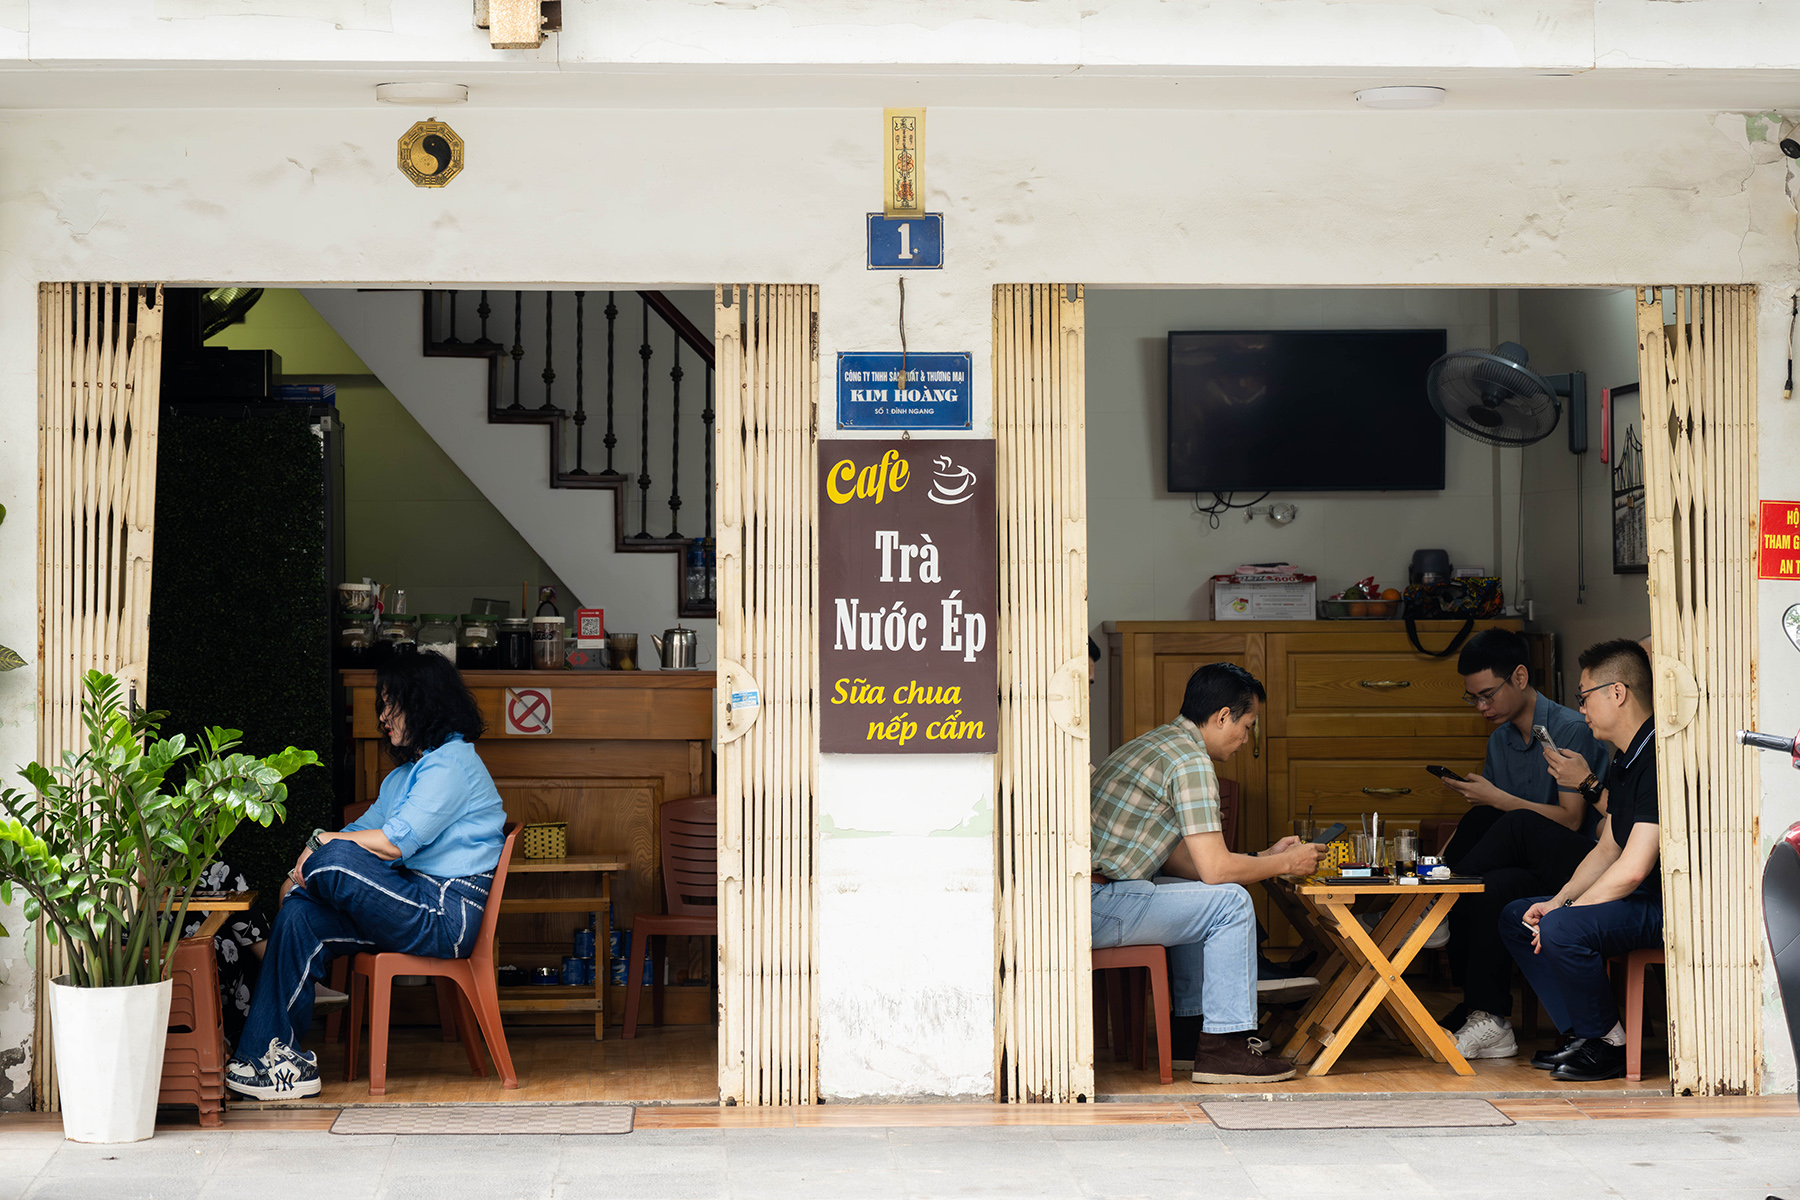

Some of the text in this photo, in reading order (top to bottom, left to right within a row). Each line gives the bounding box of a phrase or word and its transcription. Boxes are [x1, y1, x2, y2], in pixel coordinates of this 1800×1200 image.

[844, 369, 862, 382] CÔNG
[863, 371, 871, 382] TY
[871, 371, 888, 382] TNHH
[920, 370, 926, 382] &
[926, 370, 951, 382] THƯƠNG
[952, 371, 965, 384] MẠI
[850, 385, 959, 402] KIM HOÀNG
[874, 406, 885, 415] SỐ
[890, 406, 908, 415] ĐÌNH
[826, 449, 911, 505] Cafe
[1764, 534, 1791, 549] THAM
[875, 530, 942, 583] Trà
[1780, 559, 1793, 574] AN
[834, 590, 987, 663] Nước Ép
[830, 677, 962, 705] Sữa chua
[866, 710, 986, 746] nếp cẩm
